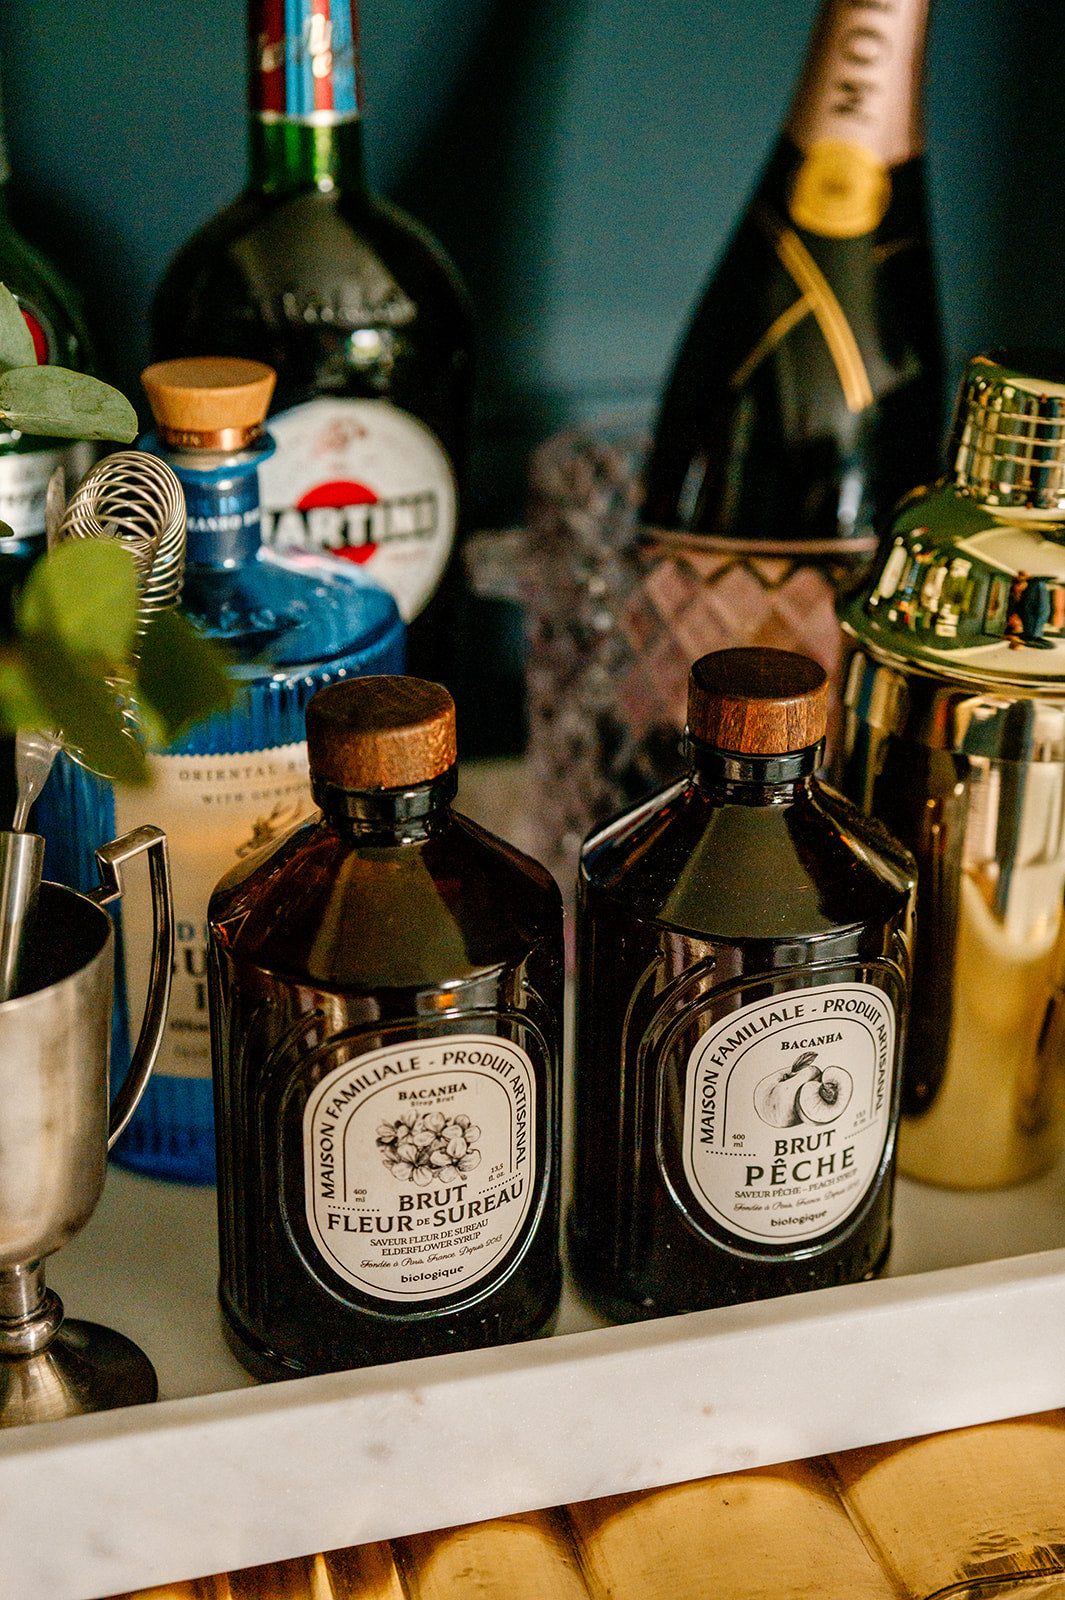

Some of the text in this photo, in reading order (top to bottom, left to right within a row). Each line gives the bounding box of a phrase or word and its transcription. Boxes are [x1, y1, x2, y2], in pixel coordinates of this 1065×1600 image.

[831, 0, 890, 116] MO
[781, 1032, 843, 1050] BACANHA
[442, 1051, 515, 1078] PRODUIT
[700, 1069, 719, 1144] MAISON
[710, 1004, 804, 1067] FAMILIALE
[823, 998, 882, 1025] PRODUIT
[876, 1024, 888, 1116] ARTISANAL
[326, 1056, 420, 1119] FAMILIALE
[398, 1082, 468, 1100] BACANHA
[509, 1075, 527, 1170] ARTISANAL
[774, 1129, 836, 1157] BRUT
[319, 1122, 335, 1199] MAISON
[745, 1146, 854, 1186] PÊCHE
[327, 1178, 524, 1233] FLEUR DE SUREAU
[399, 1183, 467, 1211] BRUT
[734, 1190, 770, 1199] SAVEUR
[772, 1188, 801, 1197] PÊCHE
[771, 1210, 827, 1227] biologique
[370, 1219, 489, 1247] SAVEUR FLEUR DE SUREAU
[382, 1231, 481, 1256] ELDERFLOWER SYRUP
[360, 1260, 391, 1269] Fondée
[401, 1266, 464, 1283] biologique
